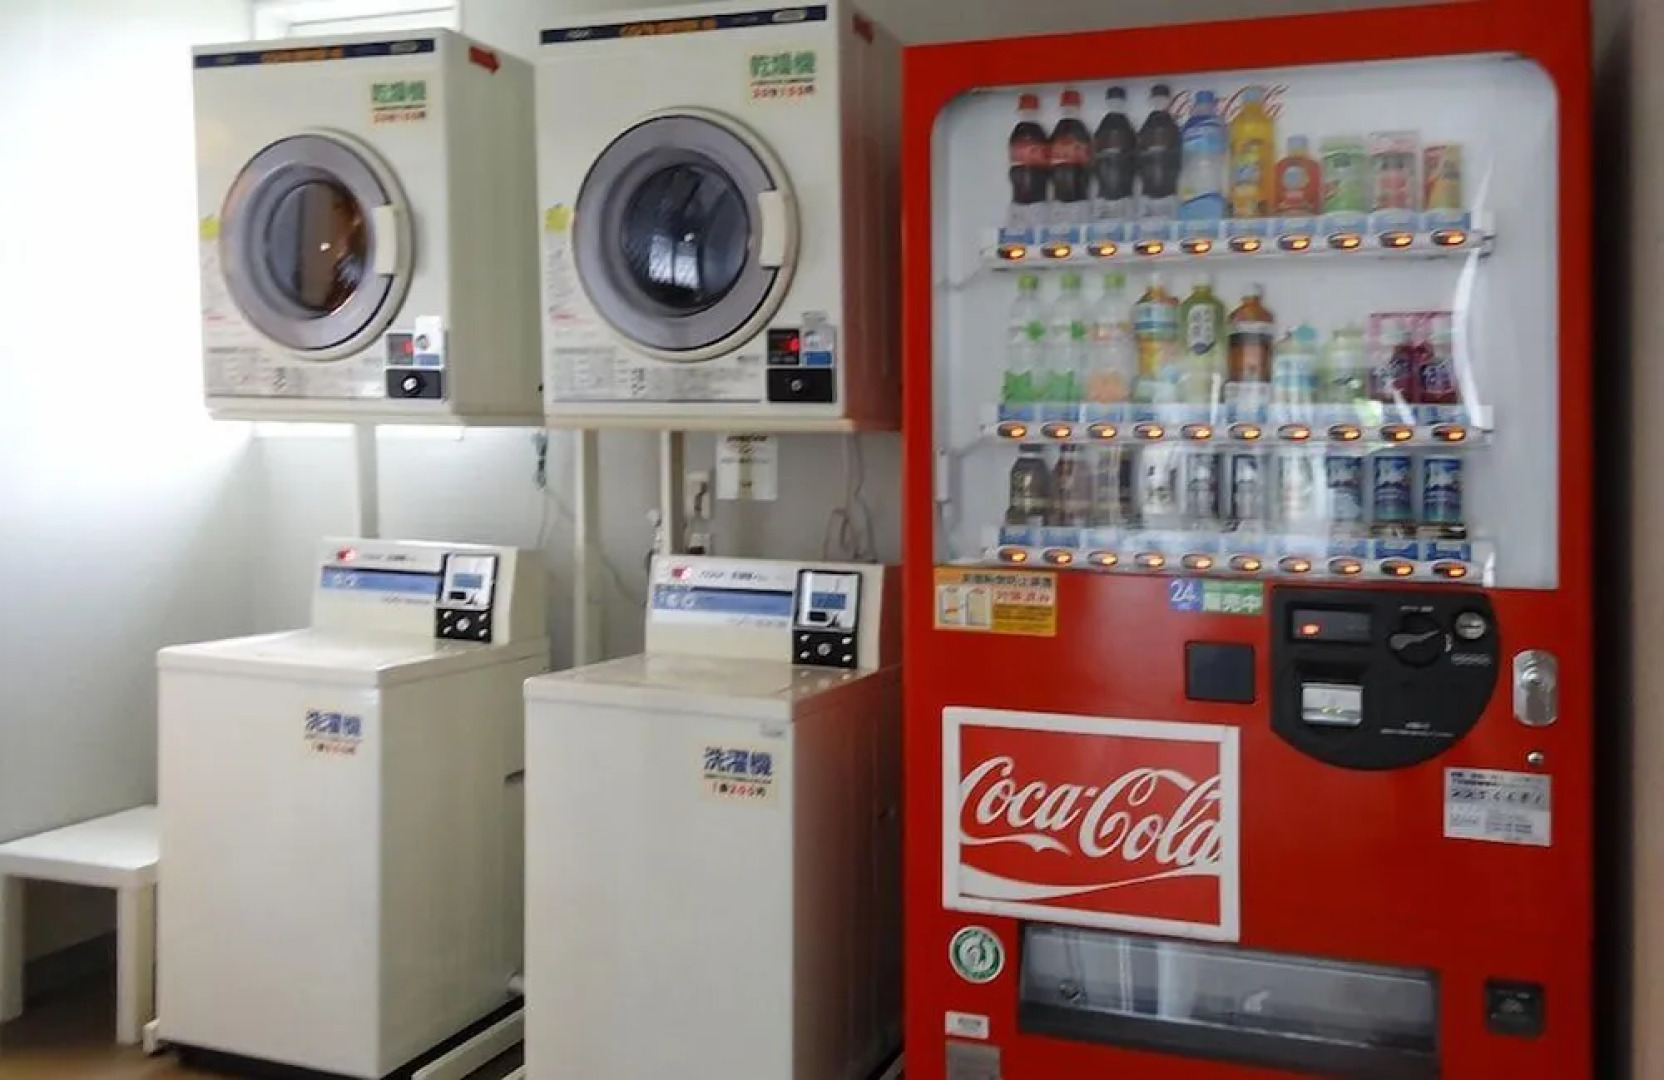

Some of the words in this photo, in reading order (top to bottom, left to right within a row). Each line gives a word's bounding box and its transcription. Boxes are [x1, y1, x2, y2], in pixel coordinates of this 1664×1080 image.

[1170, 578, 1197, 602] 24
[703, 745, 773, 776] 洗濯機
[959, 756, 1222, 866] Coca-Cola
